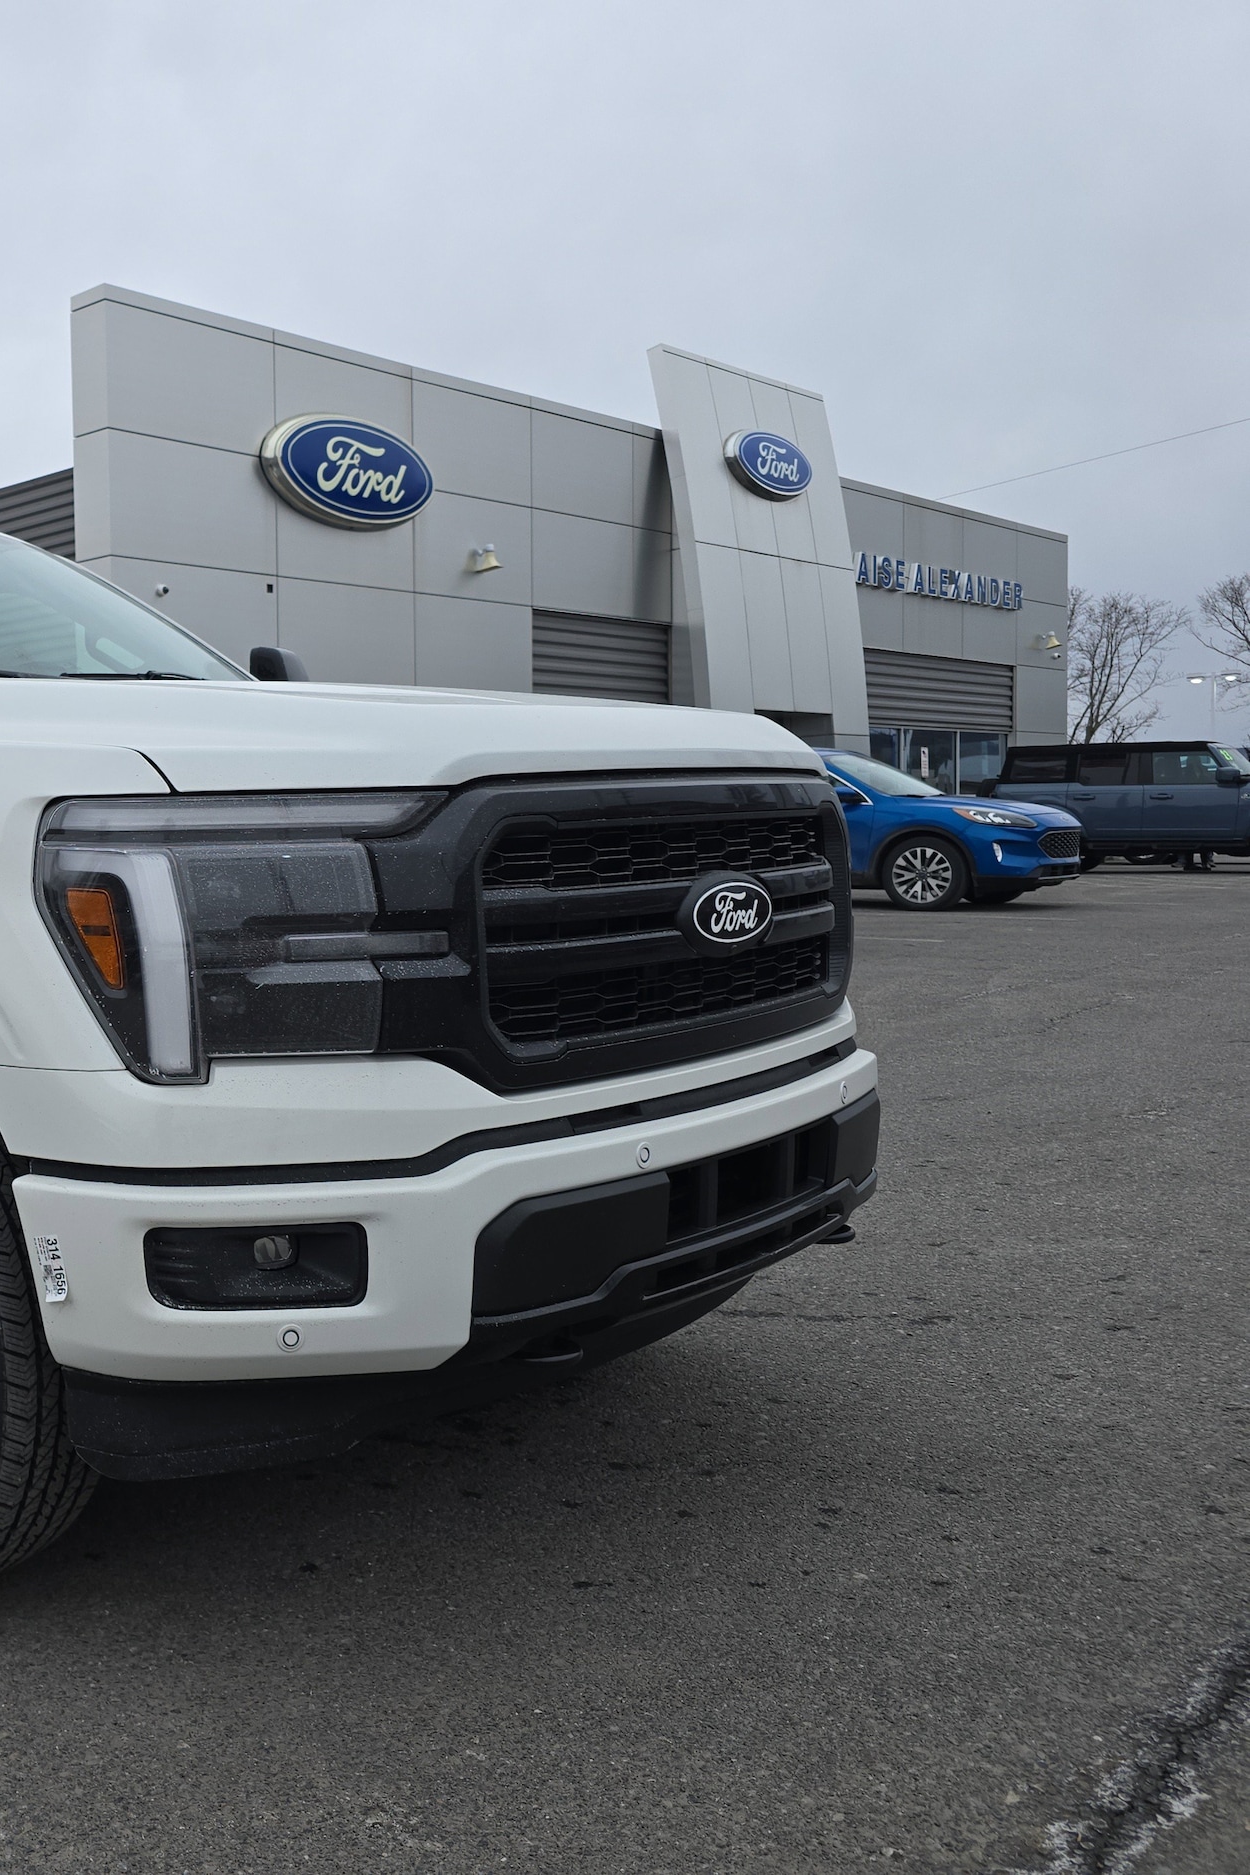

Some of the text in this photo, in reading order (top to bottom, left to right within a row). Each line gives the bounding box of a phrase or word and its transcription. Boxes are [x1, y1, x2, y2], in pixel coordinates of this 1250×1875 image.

[316, 435, 408, 505] Ford
[756, 441, 800, 483] Ford
[853, 551, 1024, 611] AISE ALEXANDER
[710, 891, 759, 934] Ford
[46, 1238, 66, 1295] 314 1656
